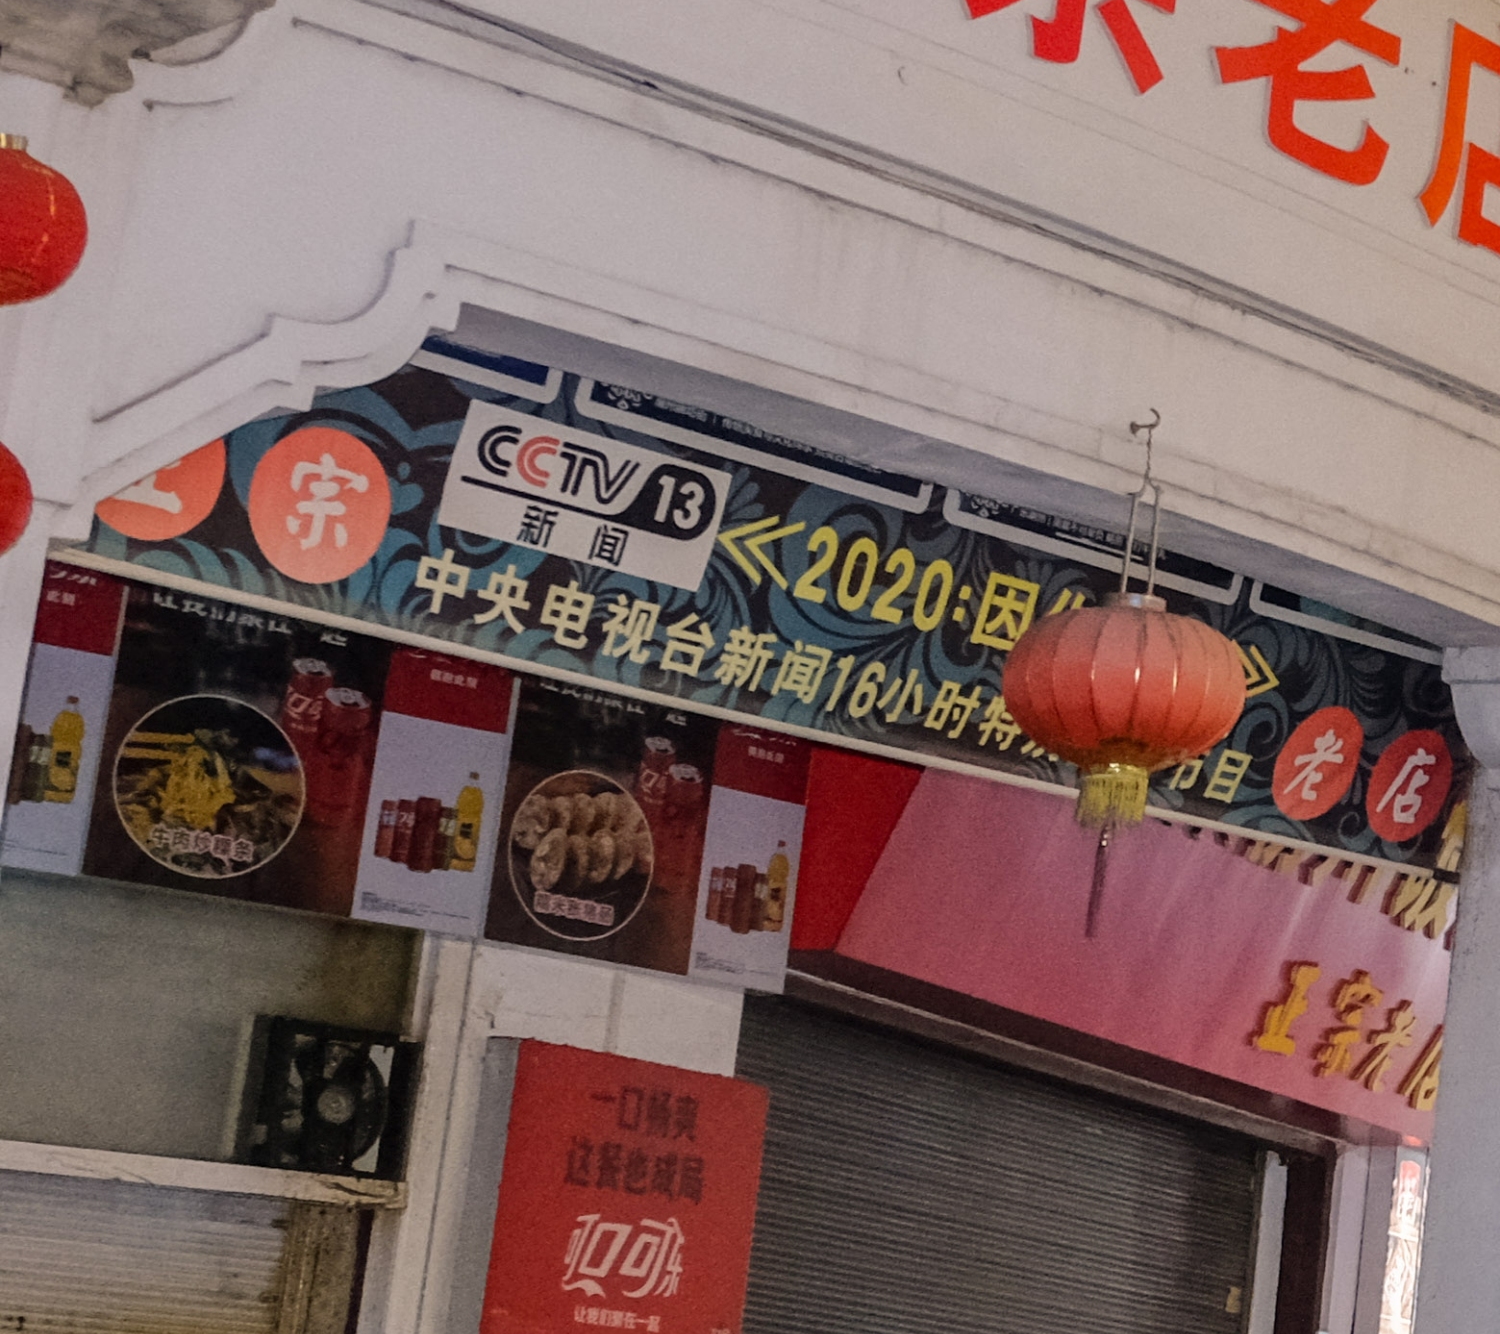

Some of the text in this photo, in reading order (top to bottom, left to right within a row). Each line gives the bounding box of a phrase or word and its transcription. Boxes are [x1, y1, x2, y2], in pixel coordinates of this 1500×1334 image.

[478, 425, 641, 520] CCTV
[651, 472, 704, 530] 13
[516, 503, 628, 566] 新闻
